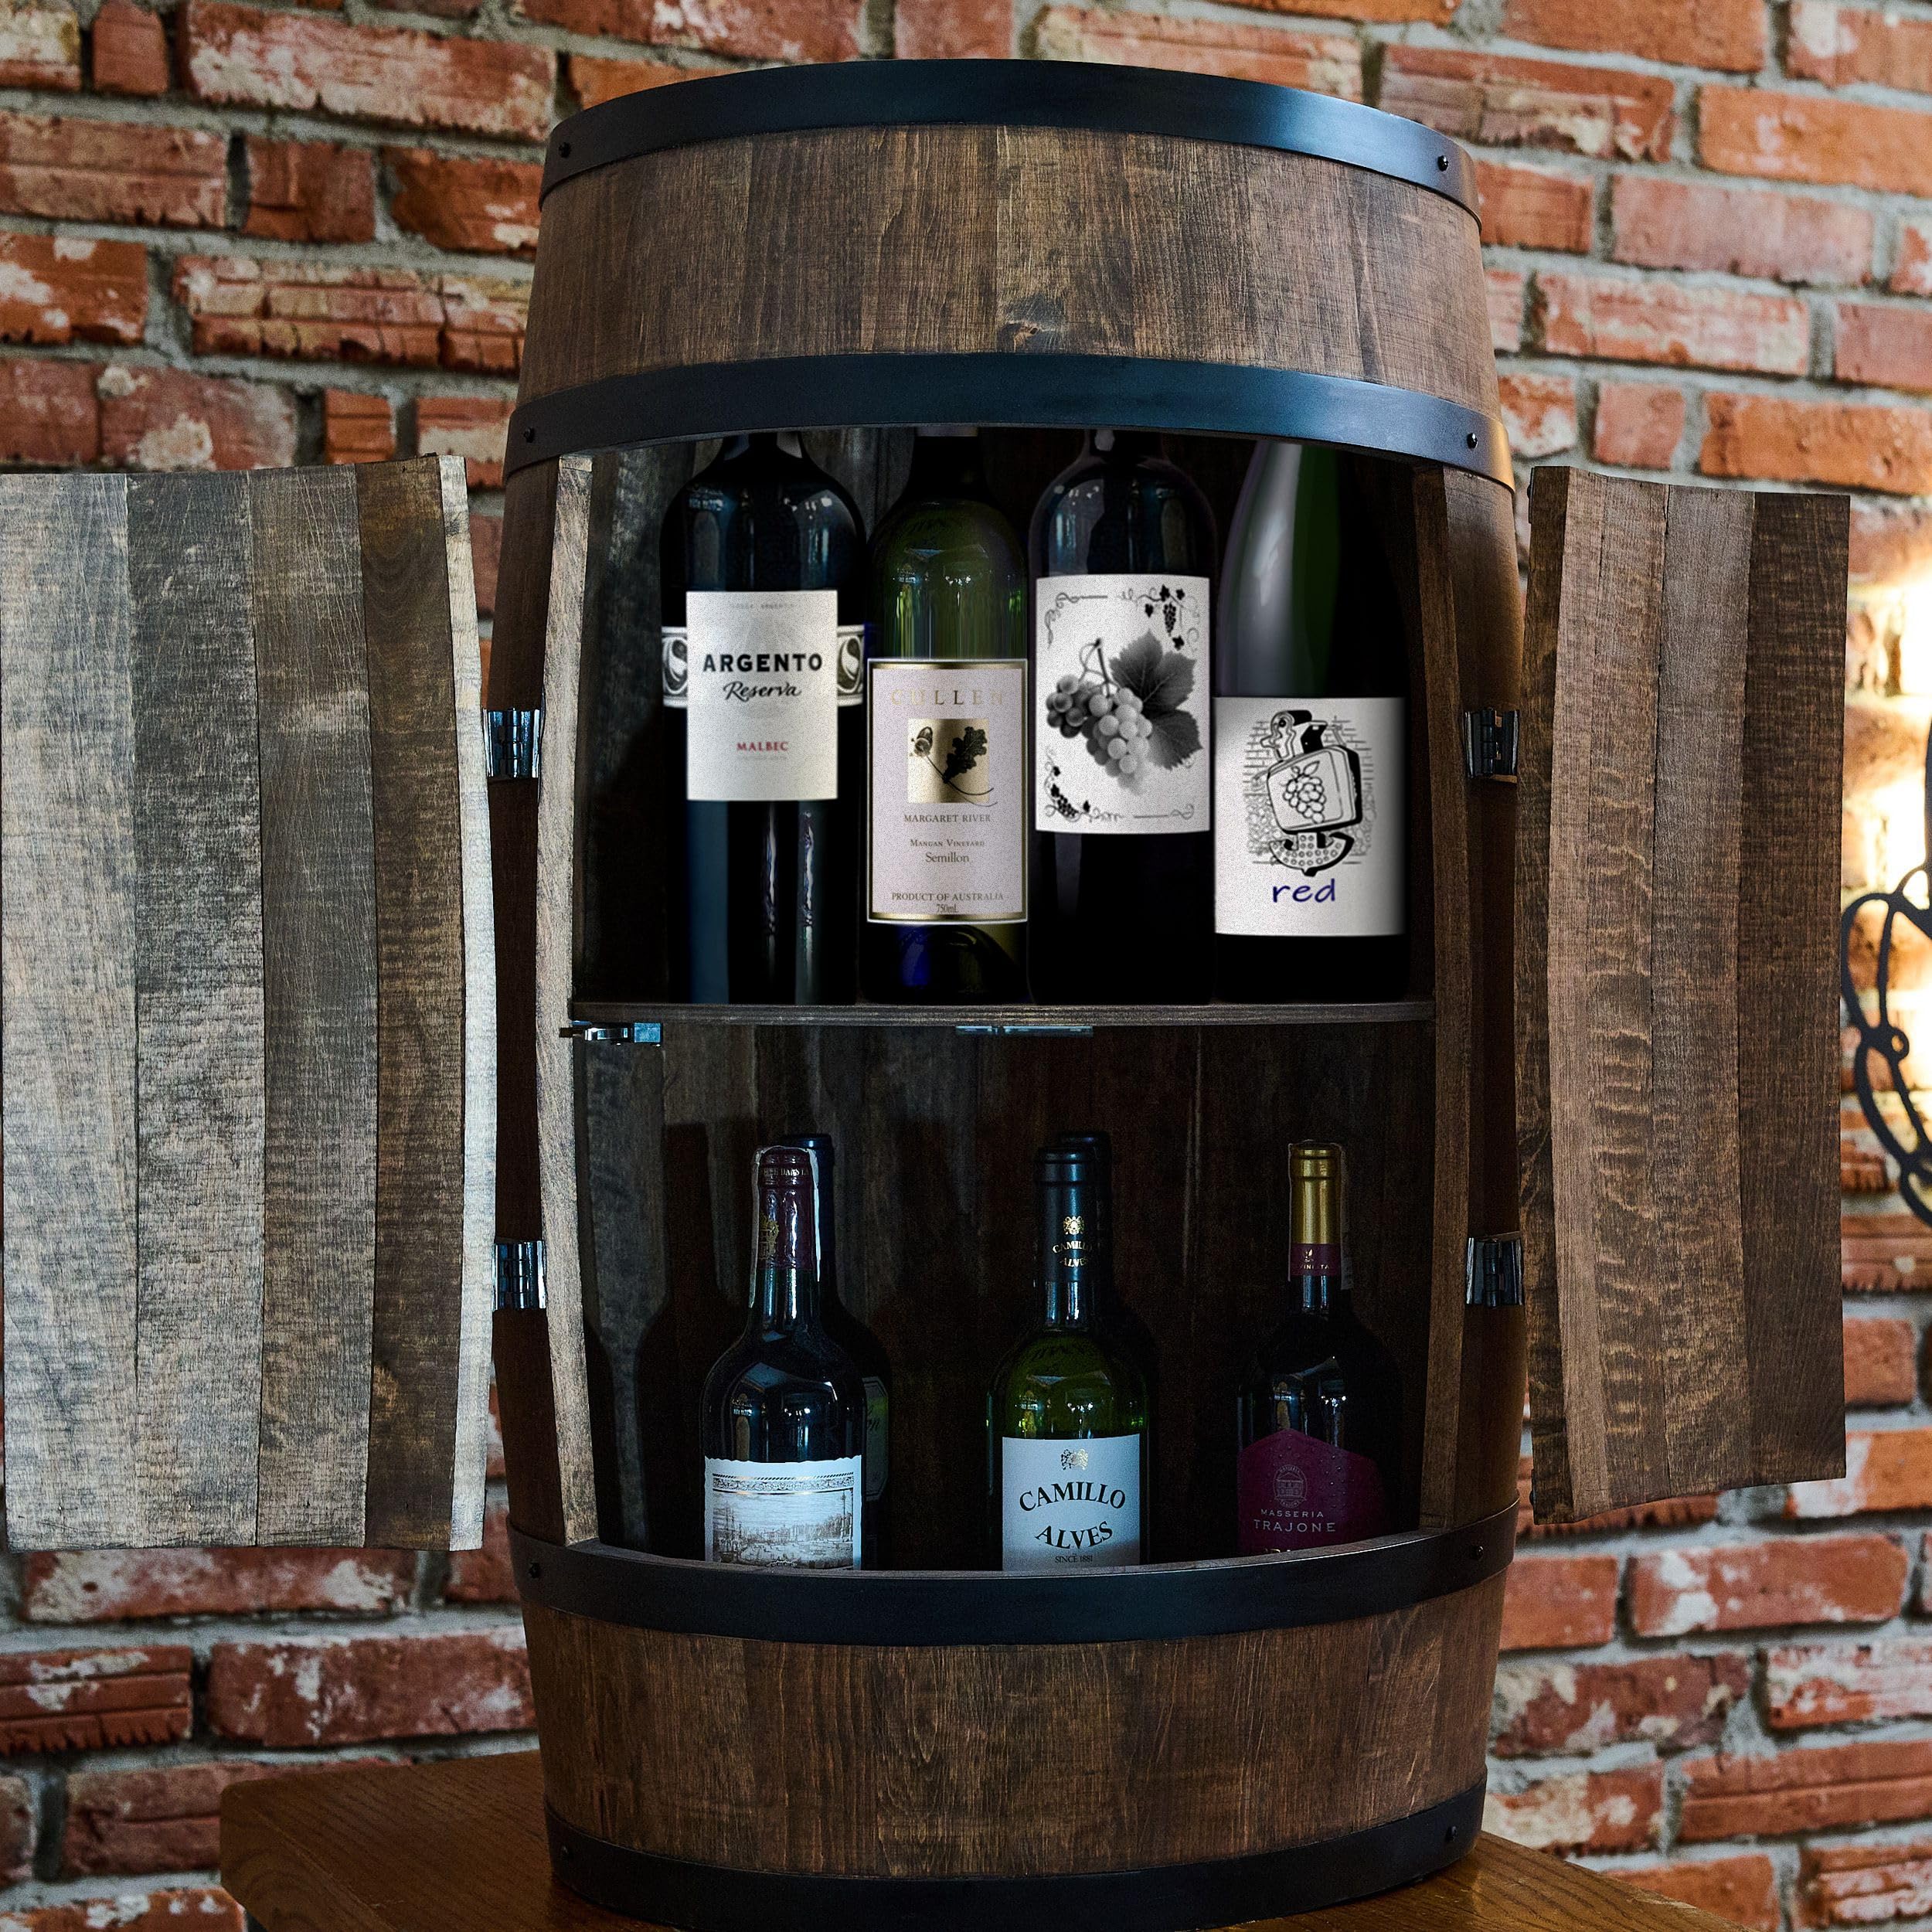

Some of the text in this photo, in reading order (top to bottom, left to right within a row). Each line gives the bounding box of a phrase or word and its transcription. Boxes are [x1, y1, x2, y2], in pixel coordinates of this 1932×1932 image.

[702, 653, 823, 672] ARGENTO
[722, 680, 802, 702] Reserva
[890, 689, 1004, 706] CULLEN
[736, 741, 789, 752] MALBEC
[903, 813, 991, 823] MARGARET RIVER
[945, 838, 986, 848] VINEYARD
[925, 851, 970, 863] Semillon
[891, 891, 1005, 902] PRODUCT OF AUSTRALIA
[1272, 877, 1336, 903] red
[1019, 1481, 1125, 1512] CAMILLO
[1260, 1509, 1324, 1518] MASSERIA
[1253, 1519, 1336, 1532] TRAJONE
[1035, 1521, 1113, 1549] ALVES
